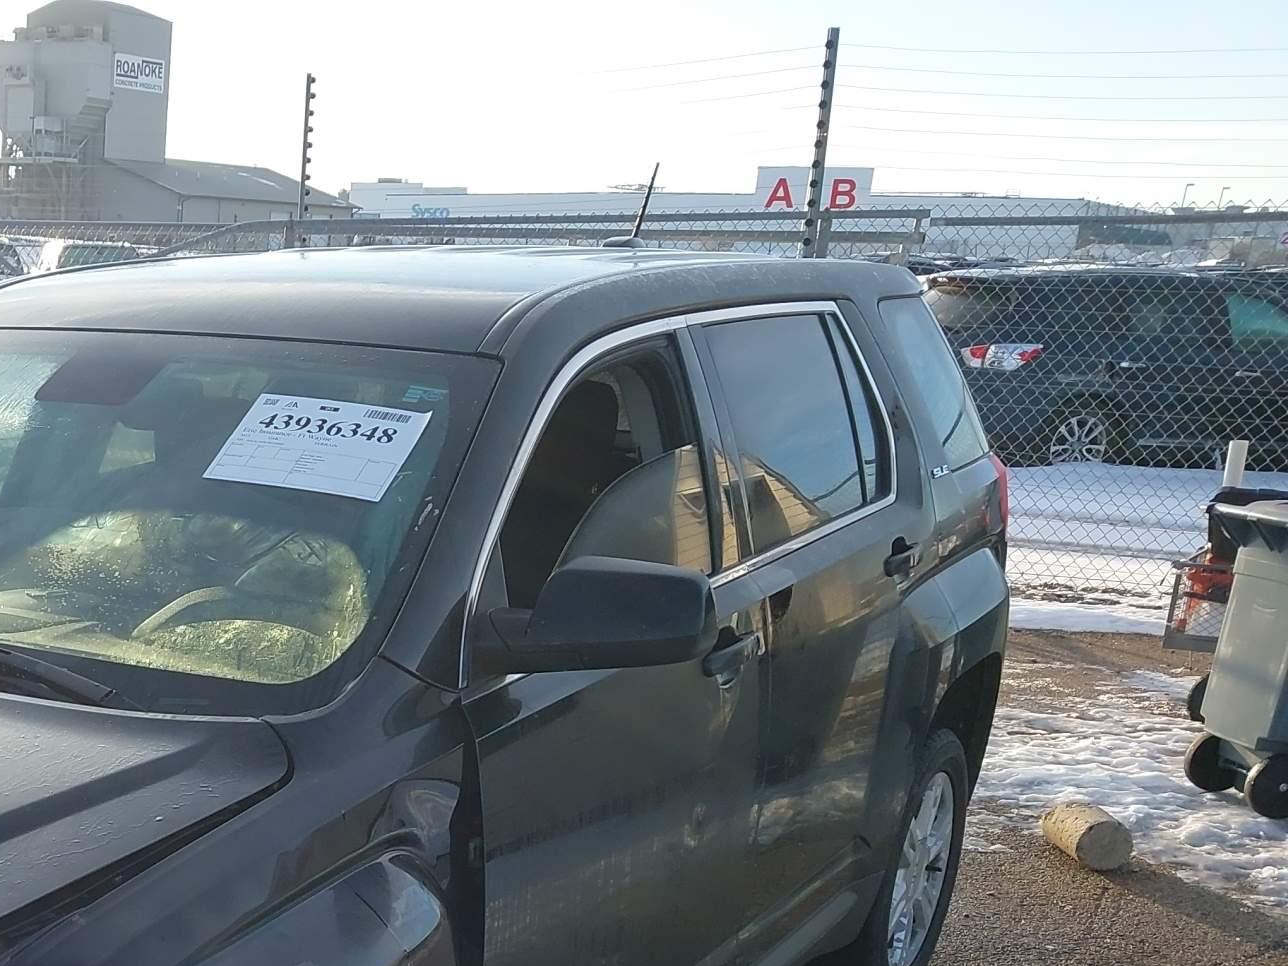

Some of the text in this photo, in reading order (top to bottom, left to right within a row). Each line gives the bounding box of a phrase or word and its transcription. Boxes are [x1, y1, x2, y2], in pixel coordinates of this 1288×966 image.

[115, 59, 164, 79] ROANOKE
[764, 178, 793, 208] A
[829, 179, 856, 209] B
[412, 203, 450, 219] Sysco
[259, 413, 398, 444] 43936348
